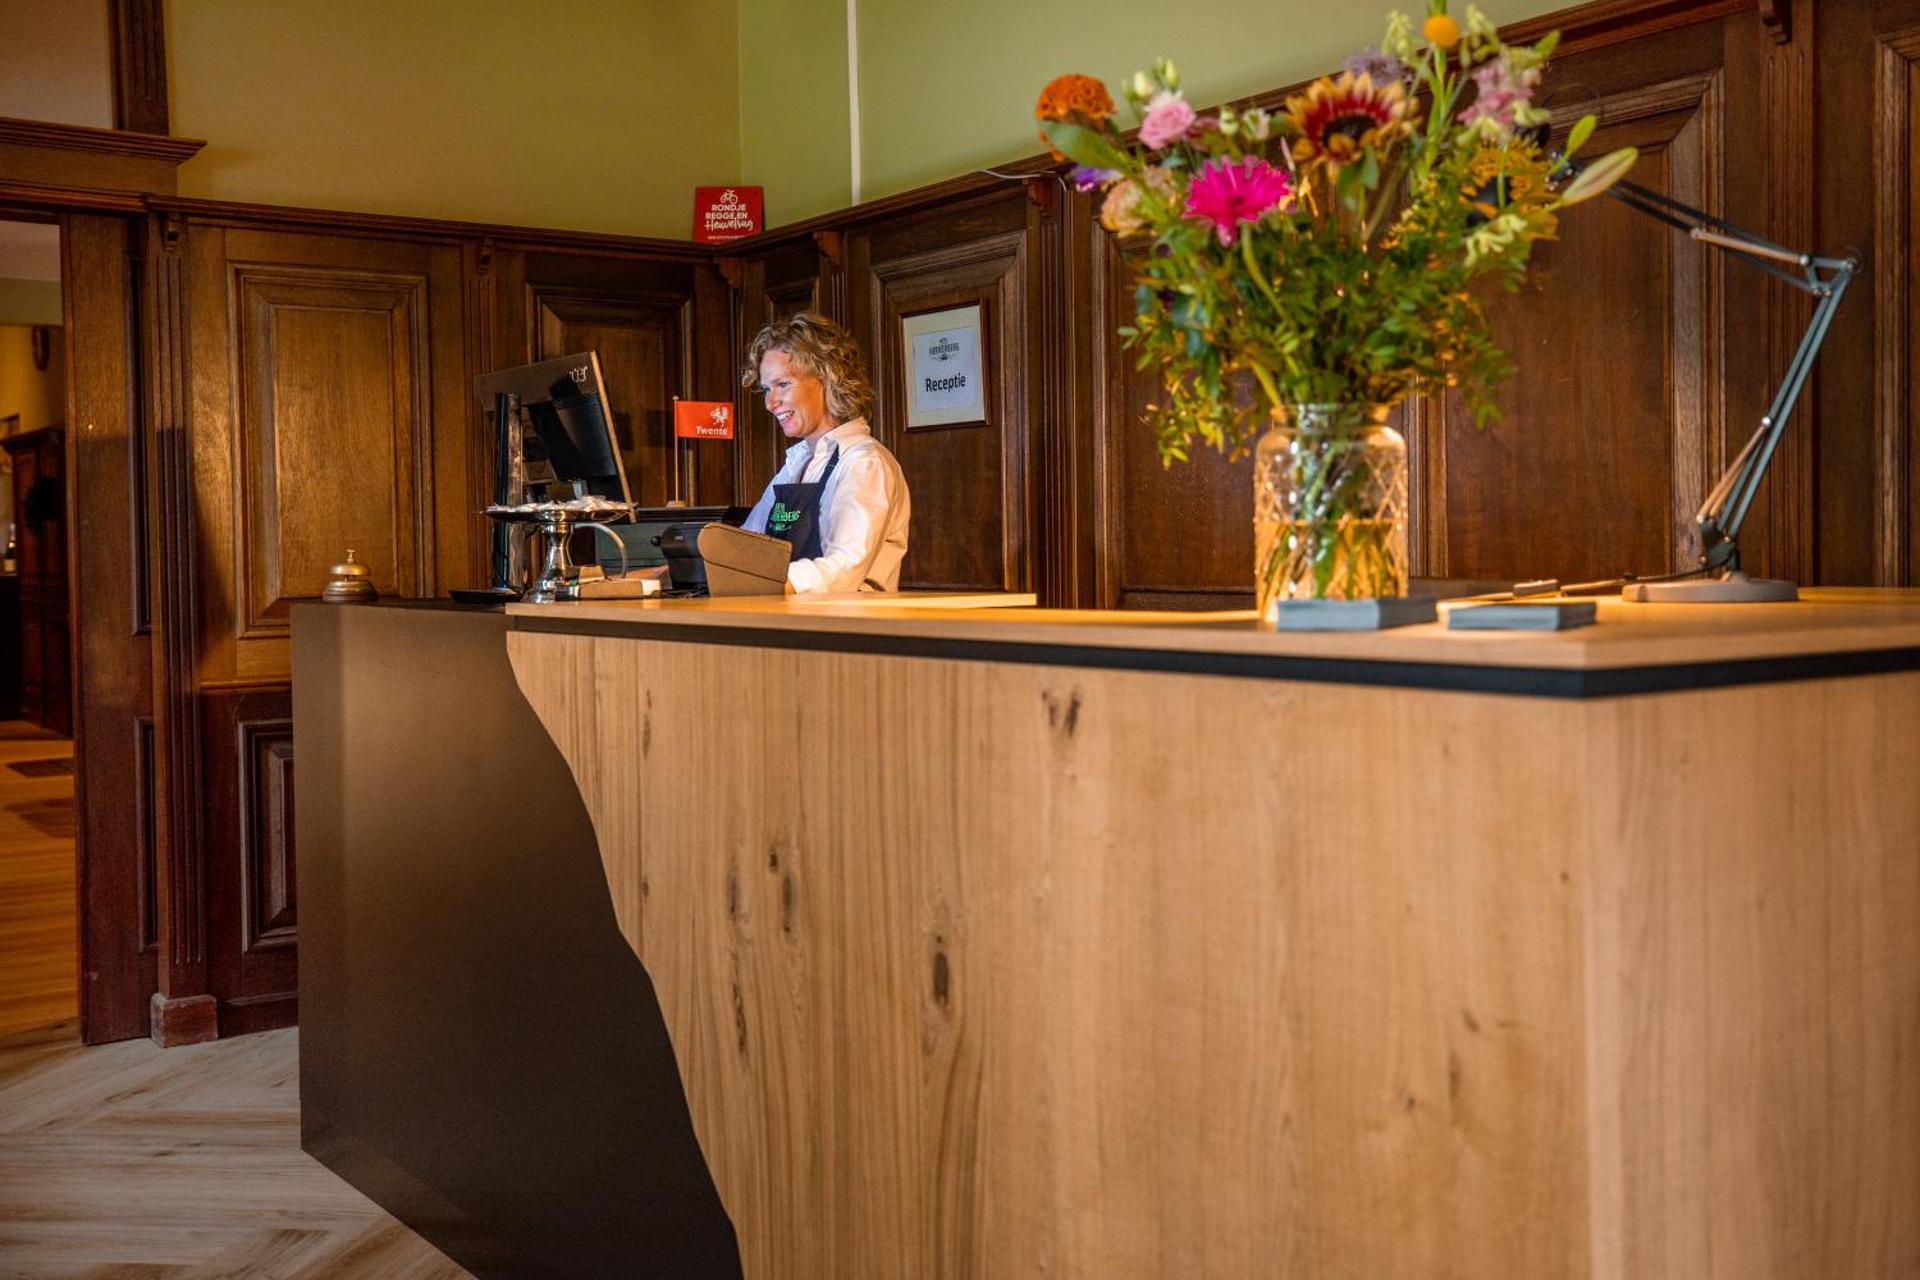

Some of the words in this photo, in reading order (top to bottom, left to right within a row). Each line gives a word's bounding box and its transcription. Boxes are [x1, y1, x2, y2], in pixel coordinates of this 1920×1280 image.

[705, 212, 735, 220] REGGE
[736, 212, 748, 220] EN
[925, 372, 966, 392] Receptie
[695, 425, 728, 437] Twente
